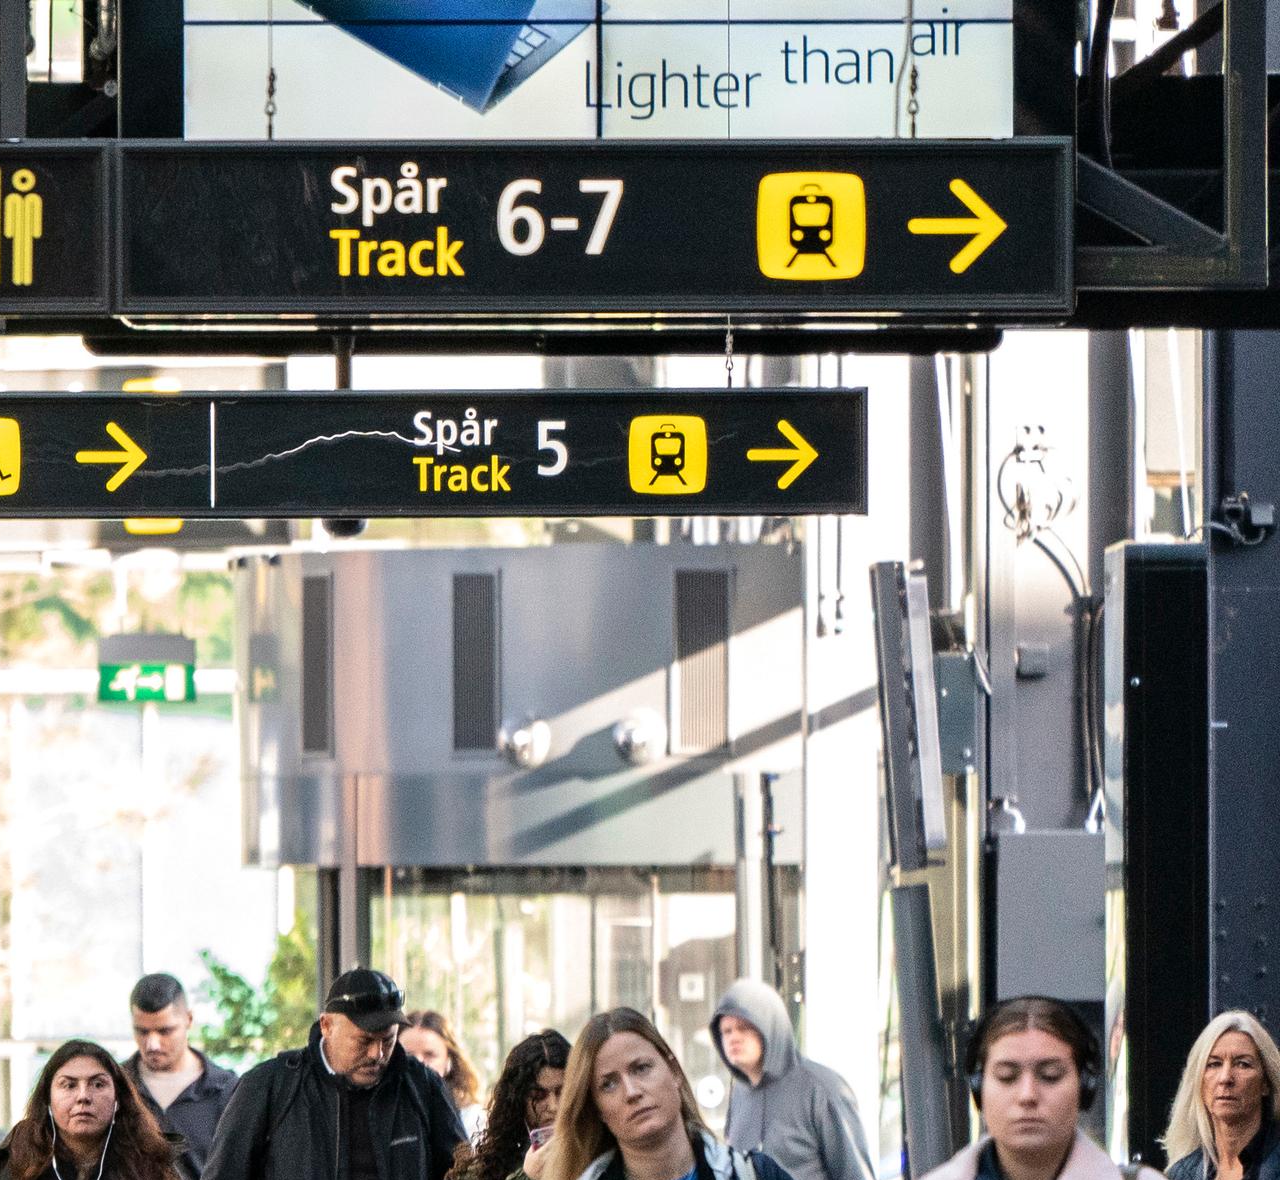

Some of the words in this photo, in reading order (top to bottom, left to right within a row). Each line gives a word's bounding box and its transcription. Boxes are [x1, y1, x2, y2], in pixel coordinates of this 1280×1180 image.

[585, 59, 761, 119] Lighter
[780, 35, 894, 84] than
[910, 6, 966, 56] air
[330, 163, 446, 226] Spår
[497, 180, 622, 255] 6-7
[330, 227, 464, 276] Track
[413, 408, 497, 454] Spår
[538, 421, 567, 475] 5
[413, 457, 510, 491] Track
